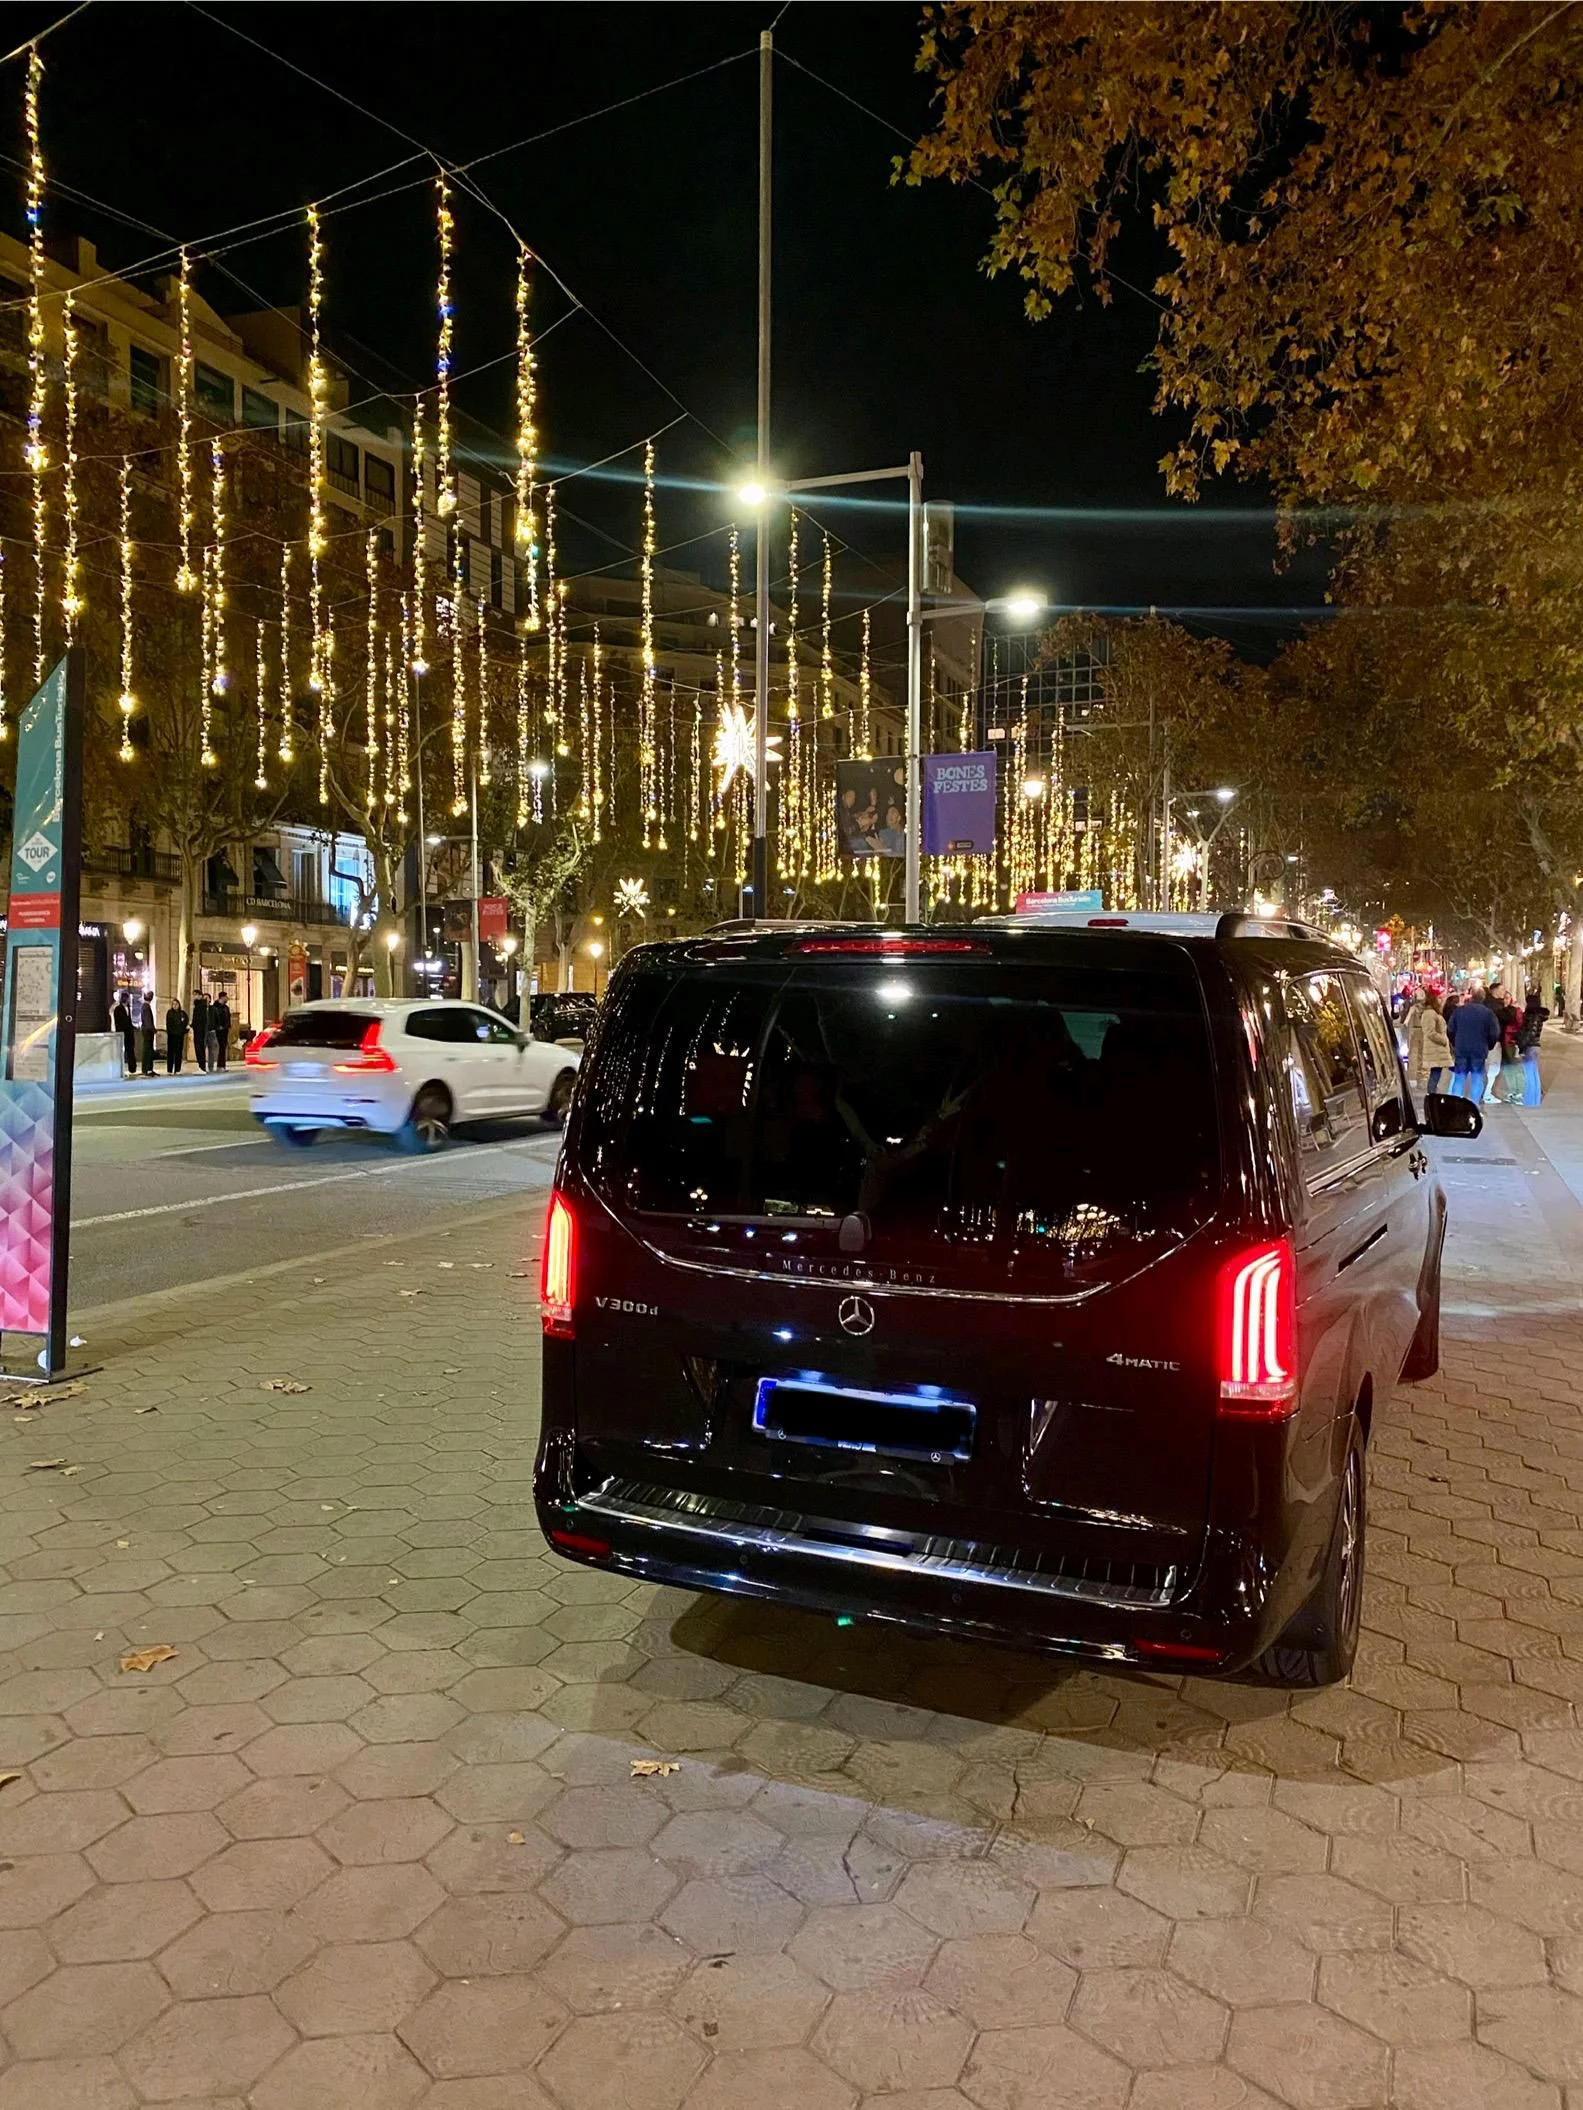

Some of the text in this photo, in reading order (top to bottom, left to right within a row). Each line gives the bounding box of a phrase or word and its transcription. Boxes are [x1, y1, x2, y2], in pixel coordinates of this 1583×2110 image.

[936, 764, 985, 781] BONES
[933, 778, 988, 794] FESTES
[24, 846, 50, 860] TOUR
[1106, 1352, 1181, 1372] 4MATIC
